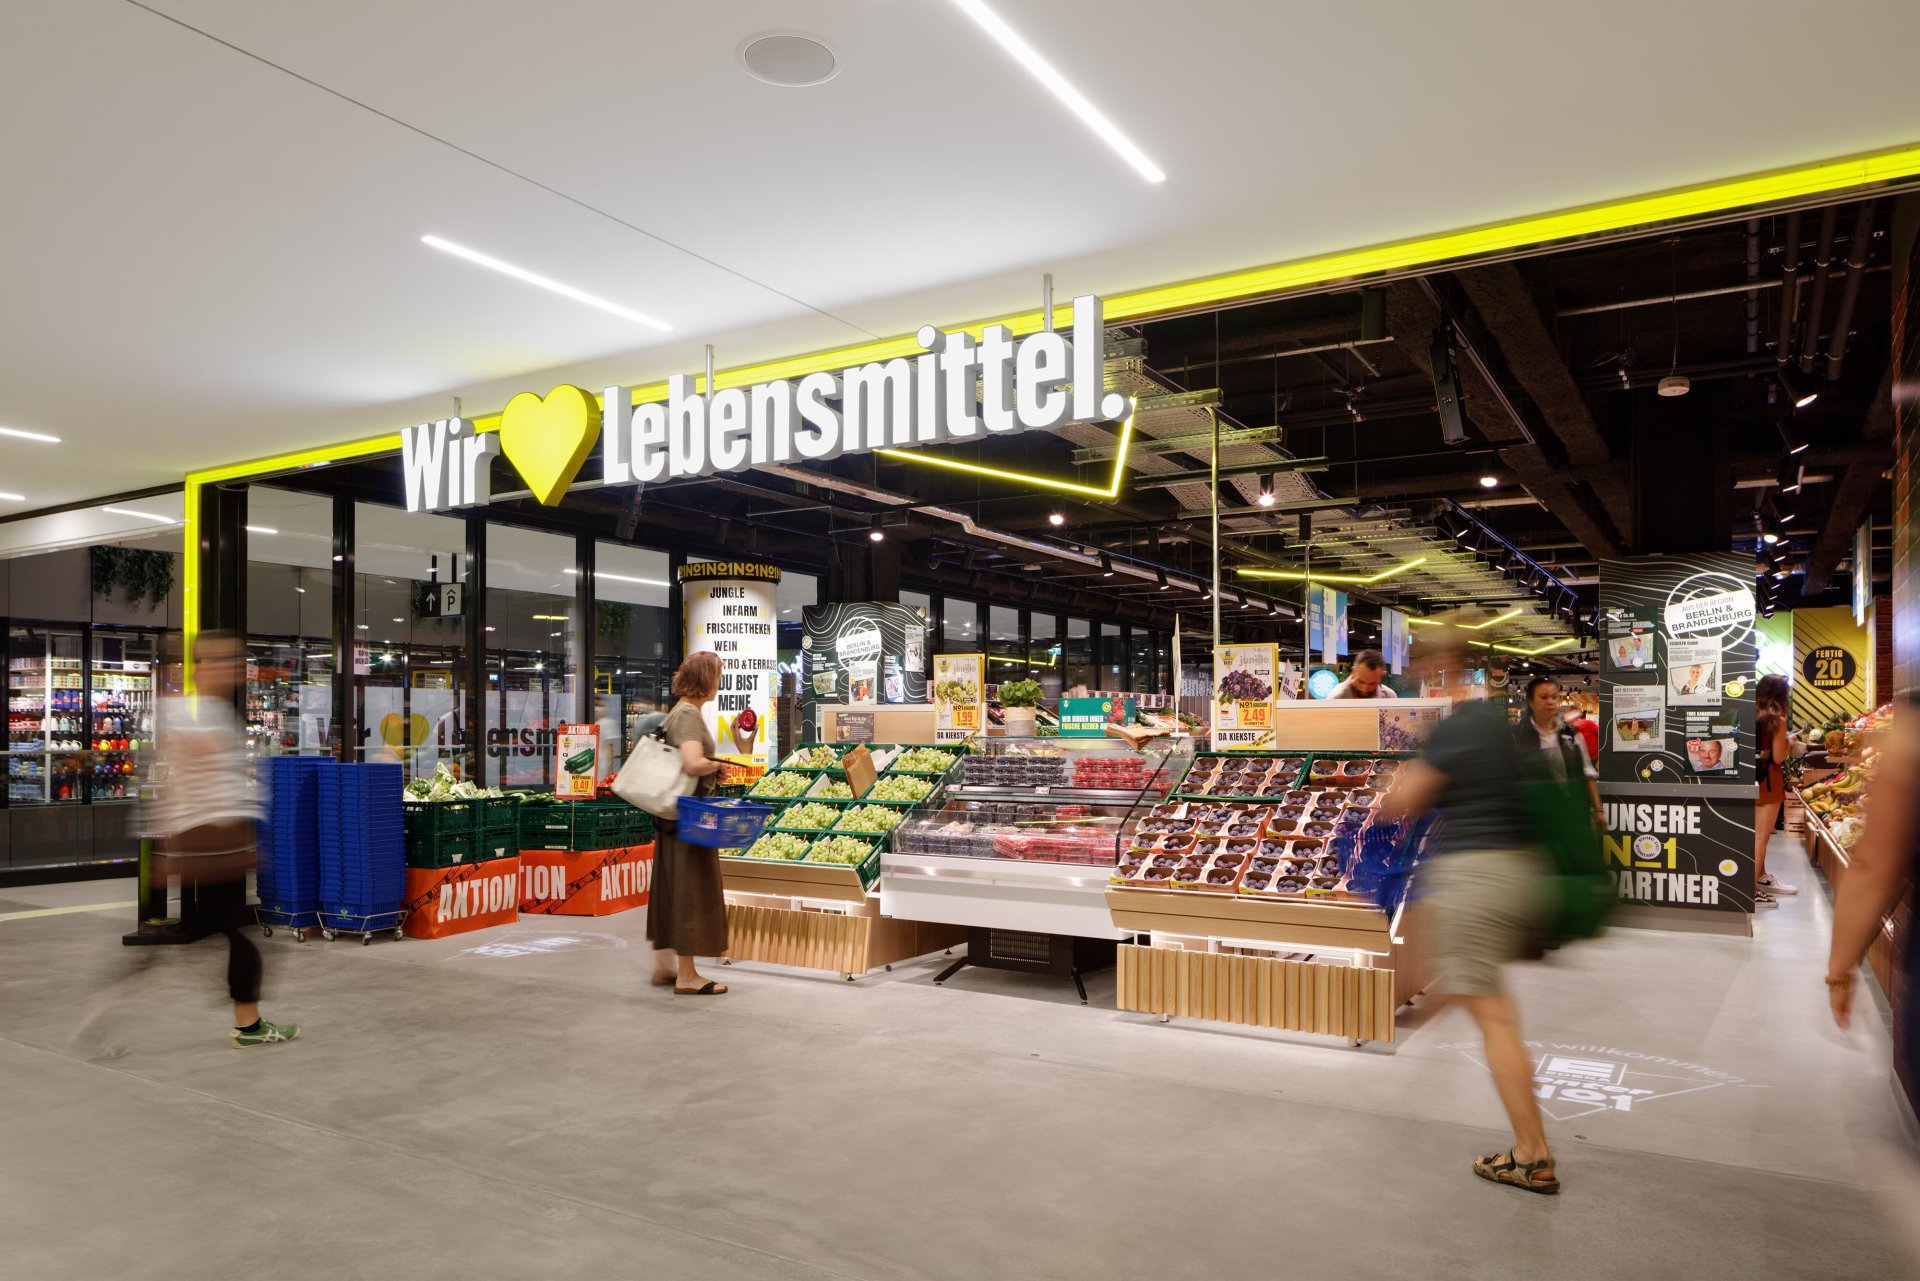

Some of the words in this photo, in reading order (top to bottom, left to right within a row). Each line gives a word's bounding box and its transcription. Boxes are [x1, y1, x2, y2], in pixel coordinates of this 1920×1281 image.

[402, 416, 496, 512] Wir
[603, 294, 1135, 485] Lebensmittel.
[709, 587, 745, 598] JUNGLE
[723, 605, 758, 617] INFARM
[1685, 606, 1723, 620] BERLIN
[1725, 604, 1734, 612] &
[1671, 609, 1752, 632] BRANDENBURG
[706, 623, 771, 635] FRISCHETHEKEN
[714, 640, 738, 652] WEIN
[1815, 649, 1843, 658] FERTIG
[741, 659, 748, 670] &
[1815, 659, 1843, 679] 20
[718, 674, 732, 691] DU
[735, 674, 759, 691] BIST
[718, 694, 751, 711] MEINE
[956, 711, 973, 723] 1.99
[1243, 708, 1266, 721] 2.49
[567, 725, 590, 735] AKTION
[937, 731, 944, 739] DA
[1218, 732, 1227, 741] DA
[1229, 732, 1256, 741] KIEKSTE
[573, 781, 589, 790] 0.49
[1602, 803, 1701, 835] UNSERE
[437, 874, 517, 923] AKTION
